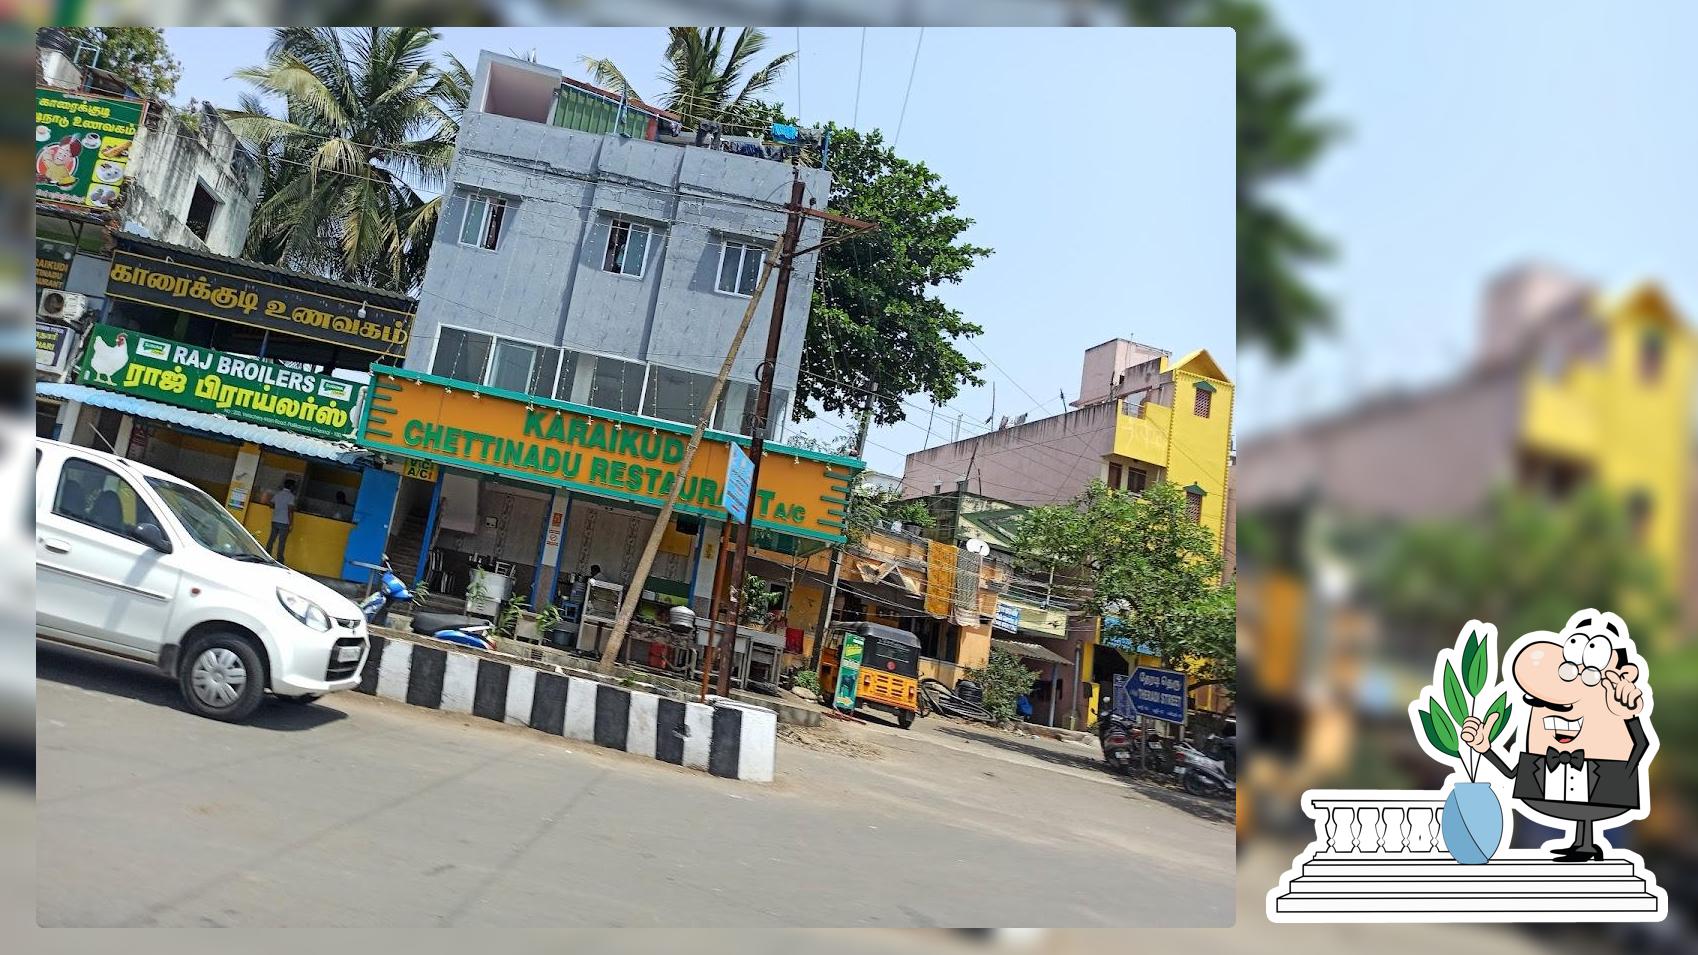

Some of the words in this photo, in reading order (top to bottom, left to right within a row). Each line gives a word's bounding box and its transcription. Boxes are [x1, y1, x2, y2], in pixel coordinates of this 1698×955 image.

[39, 98, 111, 118] காரைக்குடி
[73, 116, 136, 135] உணவகம்
[110, 262, 259, 315] காரைக்குடி
[264, 300, 408, 345] உணவகம்
[123, 363, 188, 393] ராஜ்
[194, 374, 348, 428] பிராய்லர்ஸ்
[173, 346, 213, 370] RAJ
[216, 356, 316, 393] BROILERS
[523, 410, 686, 465] KARAIKUD
[403, 419, 582, 479] CHETTINADU
[590, 456, 777, 517] RESTAURT
[775, 502, 805, 522] A/C
